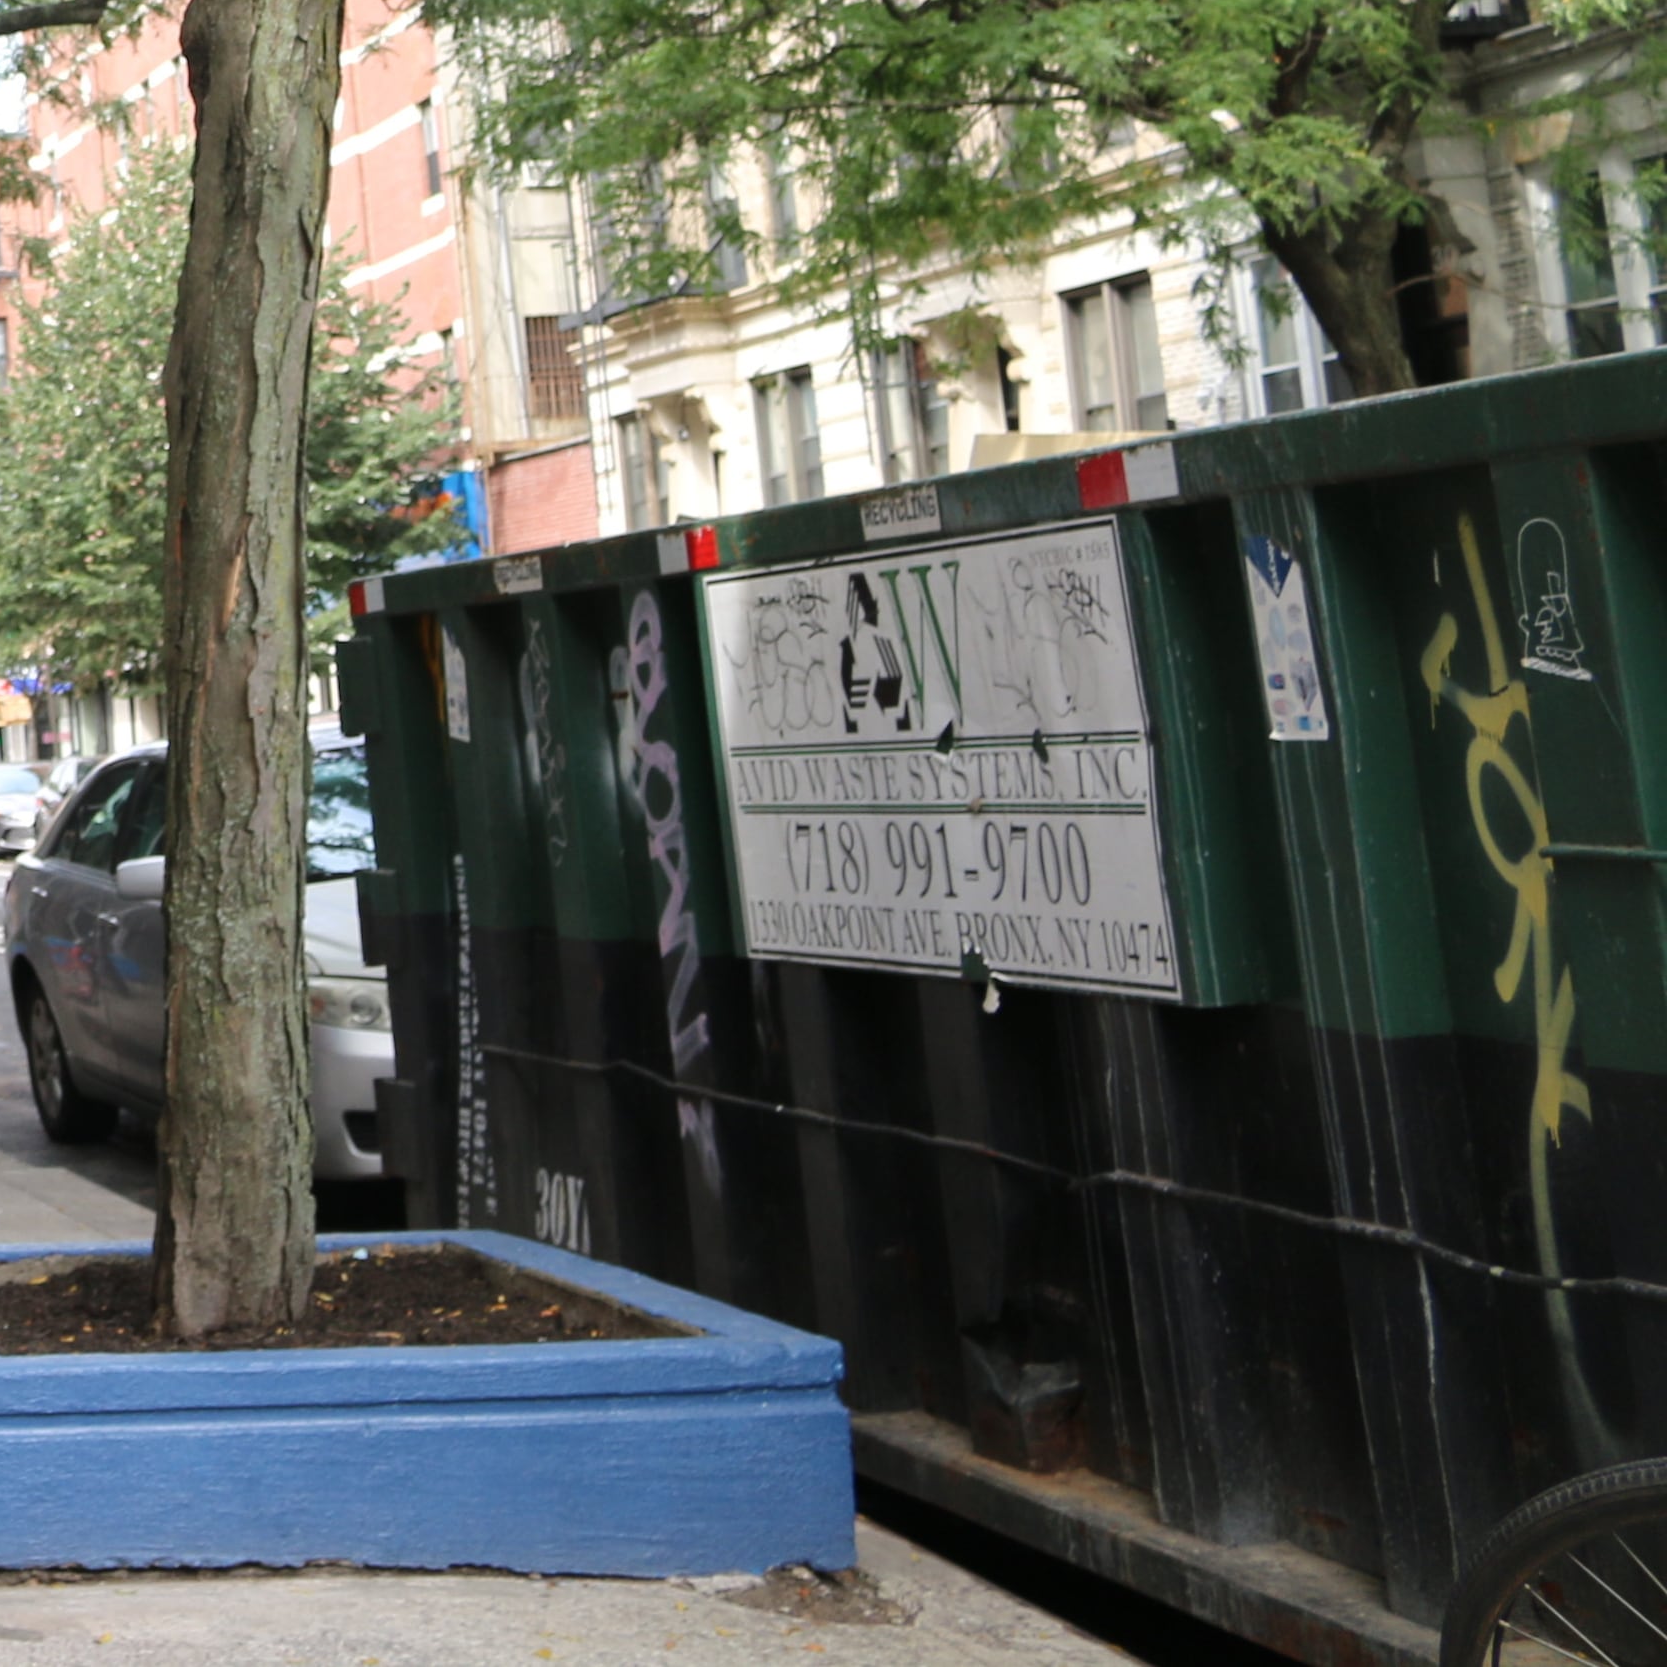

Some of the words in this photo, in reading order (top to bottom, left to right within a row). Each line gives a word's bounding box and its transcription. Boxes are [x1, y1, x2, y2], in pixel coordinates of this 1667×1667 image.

[864, 494, 937, 526] RECYCLING
[738, 758, 798, 802] AVID
[805, 755, 900, 801] WASTE
[1073, 746, 1148, 800] INC.
[786, 820, 868, 896] (718)
[886, 821, 1092, 907] 991-9700
[750, 900, 793, 946] 1330
[794, 902, 895, 954] OAKPOINT
[903, 909, 953, 959] AVE.
[1055, 917, 1092, 970] NY
[1100, 919, 1169, 976] 10474
